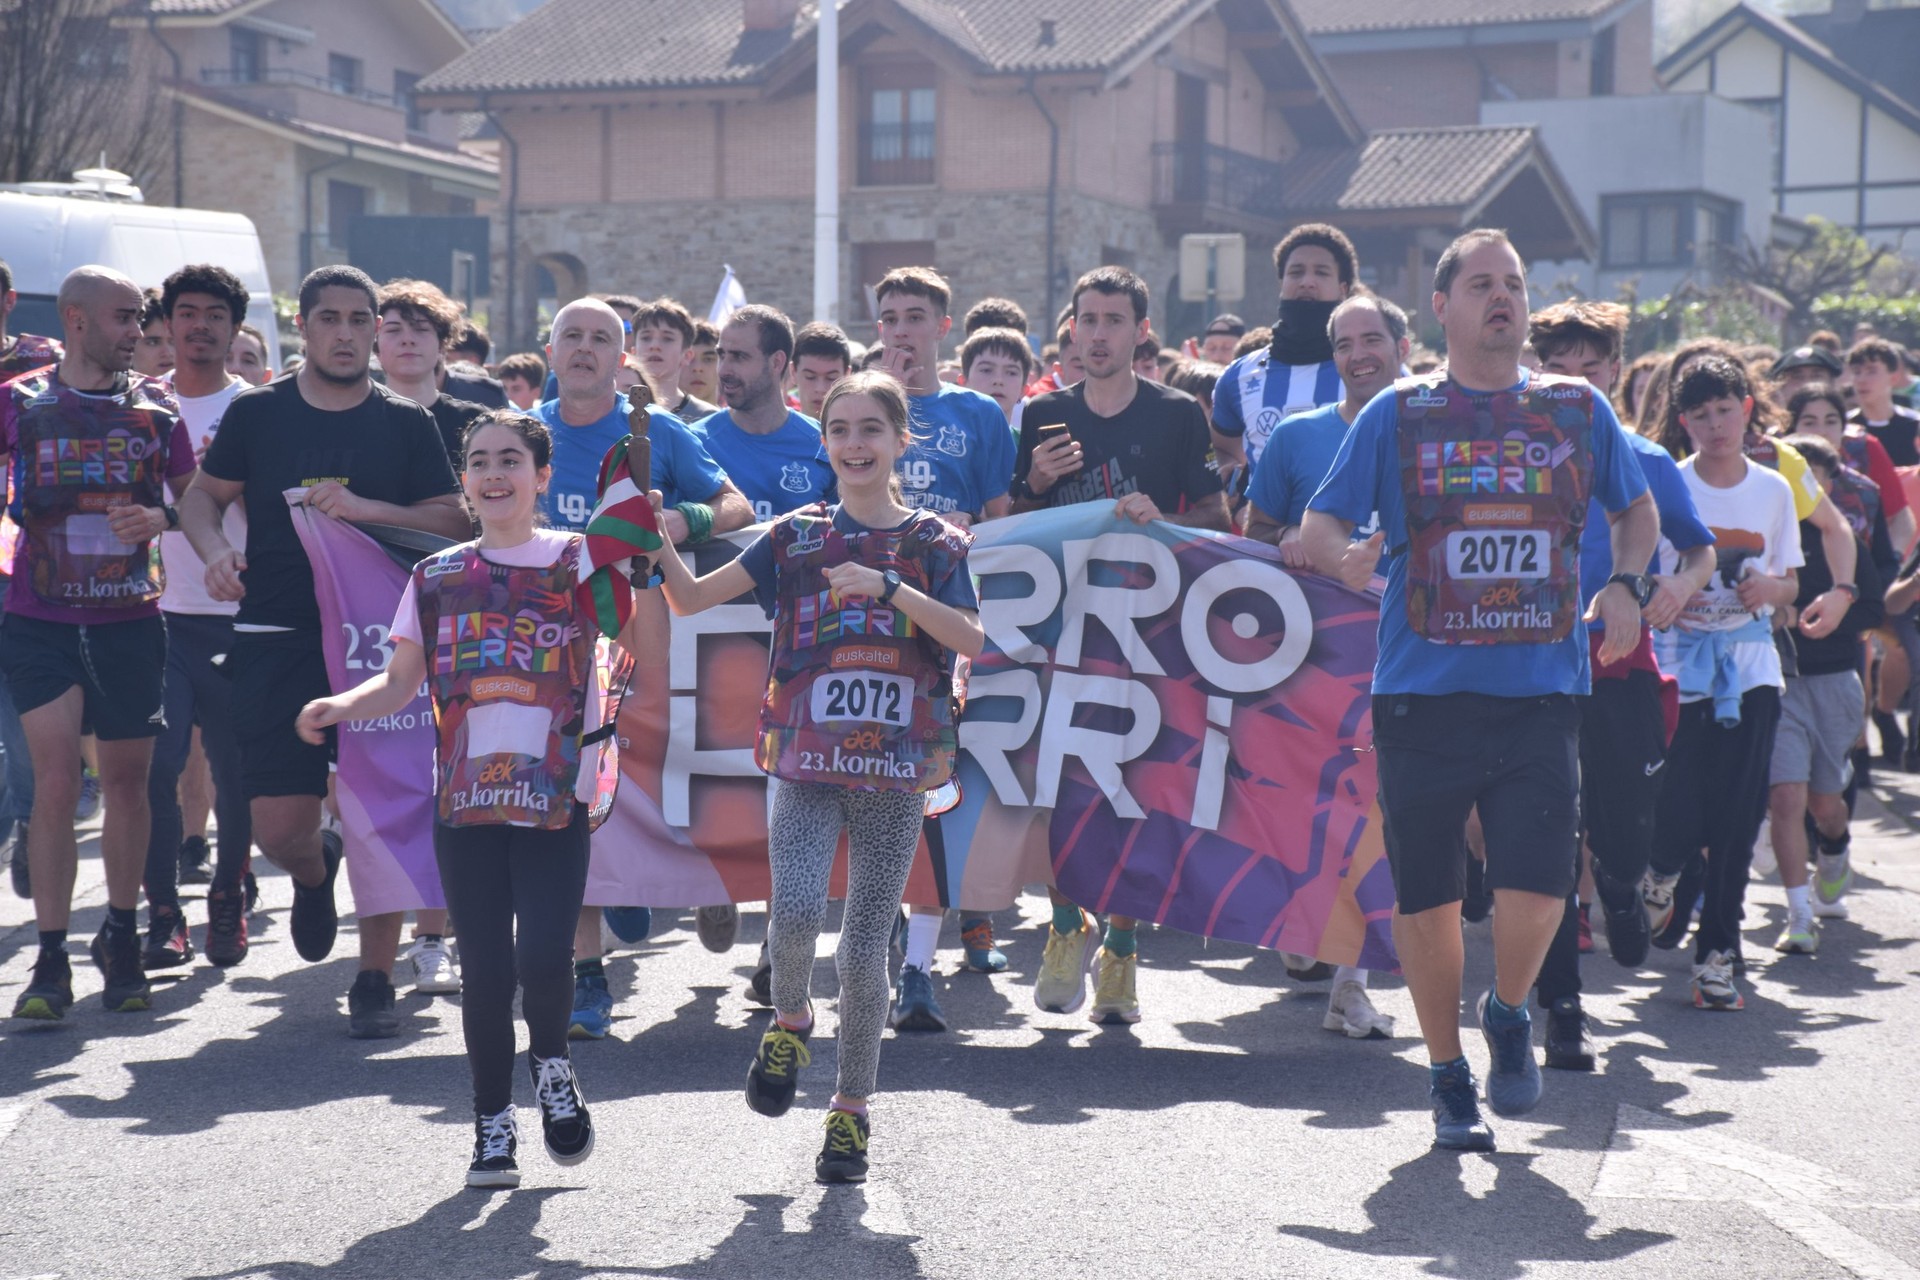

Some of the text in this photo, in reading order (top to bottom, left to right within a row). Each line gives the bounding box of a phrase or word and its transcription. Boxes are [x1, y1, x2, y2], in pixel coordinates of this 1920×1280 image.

[1553, 387, 1583, 400] eitb
[1468, 508, 1527, 520] euskaltel
[1460, 534, 1538, 574] 2072
[1481, 580, 1522, 607] aek
[835, 649, 894, 664] euskaltel
[475, 680, 531, 696] euskaltel
[825, 678, 901, 722] 2072
[346, 713, 416, 732] 024ko
[843, 725, 885, 752] aek
[479, 754, 518, 784] aek
[799, 746, 918, 778] 23.korrika
